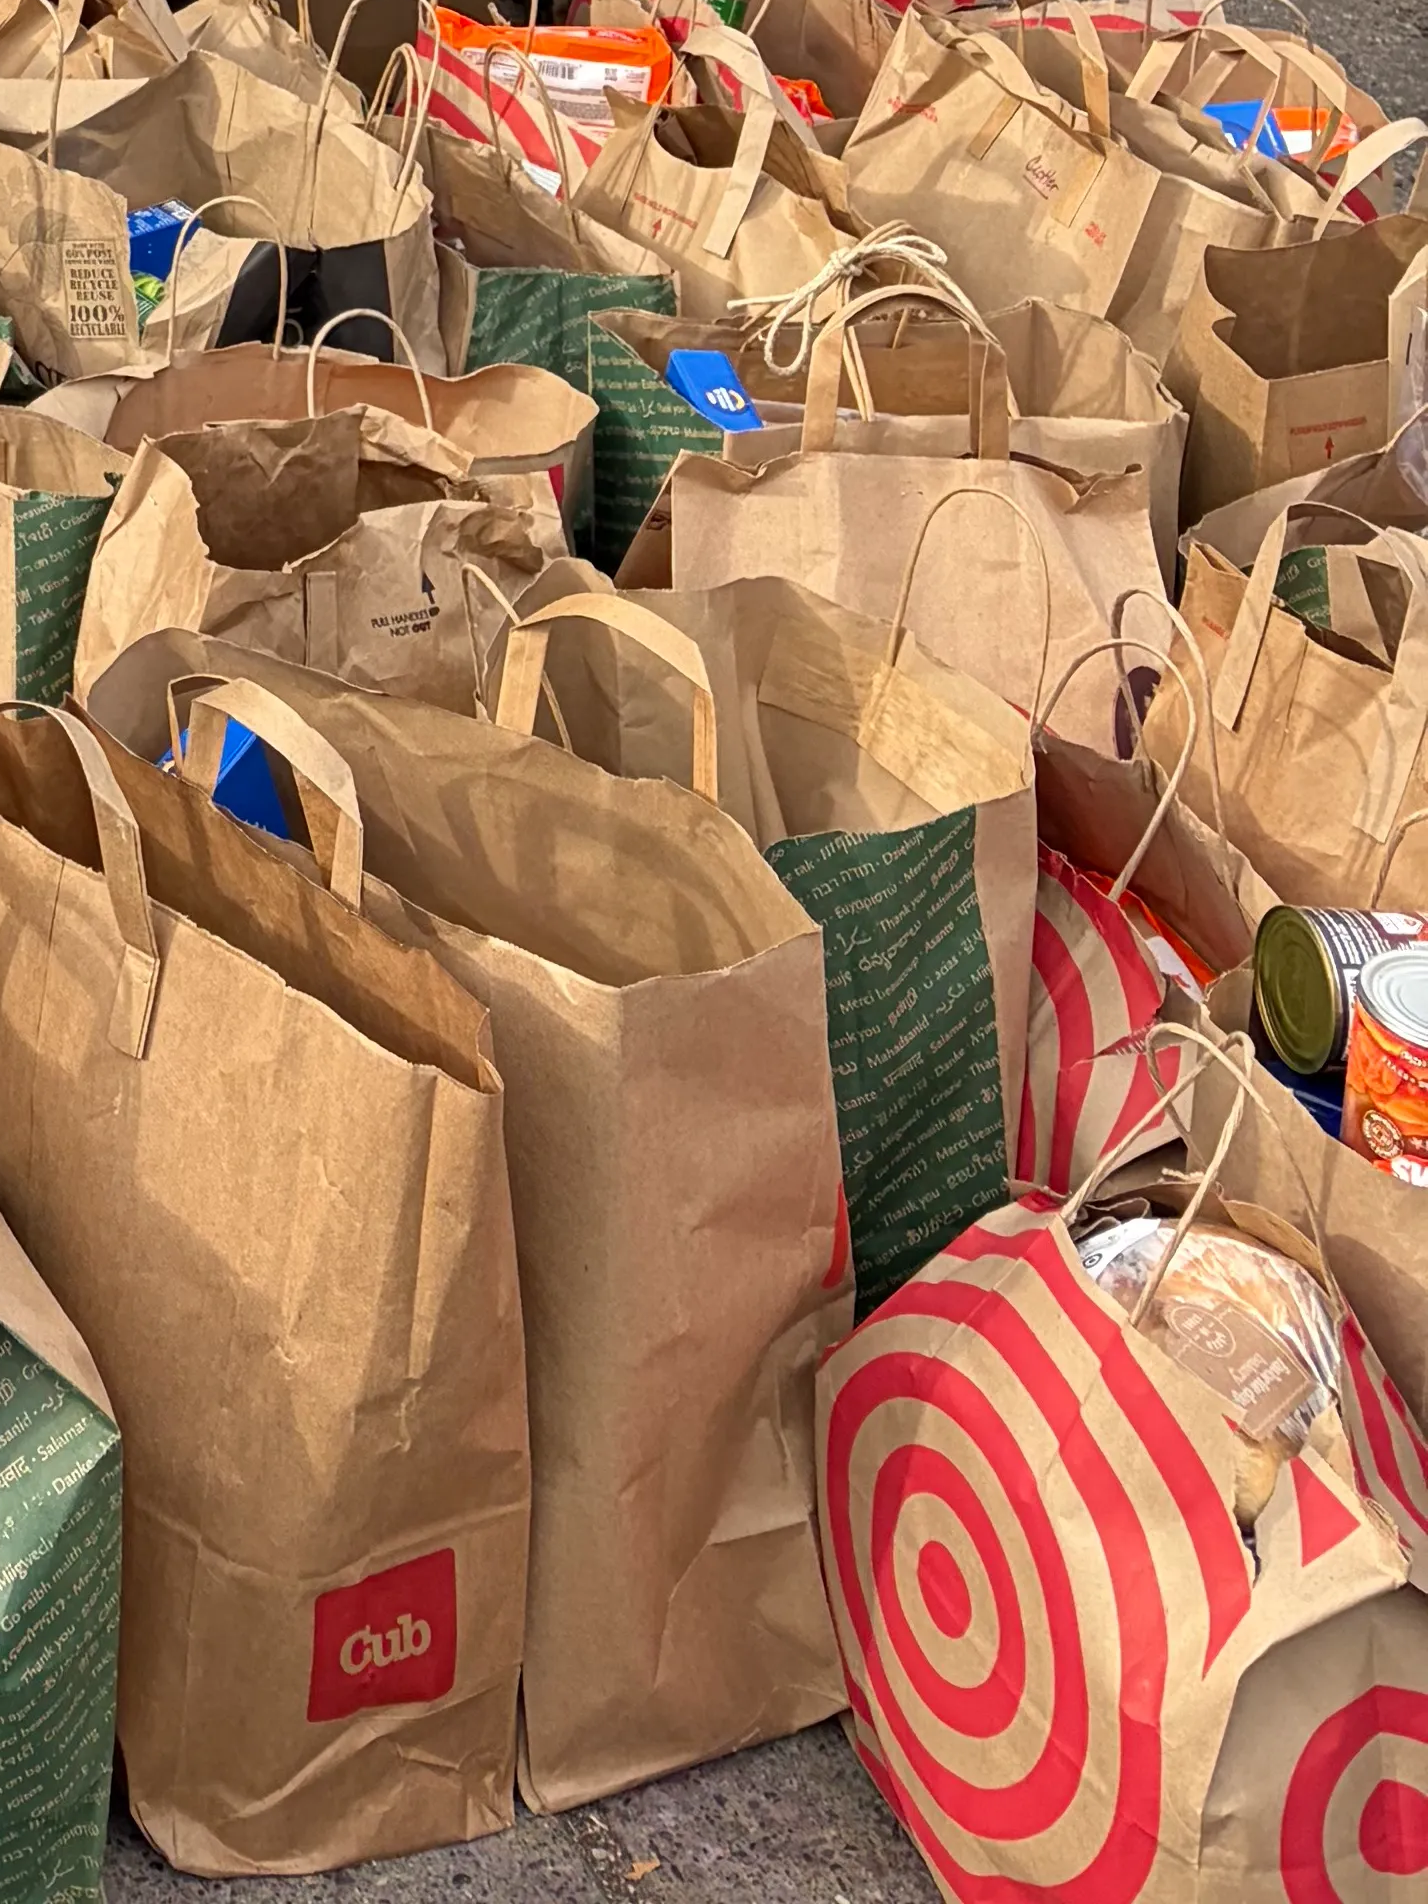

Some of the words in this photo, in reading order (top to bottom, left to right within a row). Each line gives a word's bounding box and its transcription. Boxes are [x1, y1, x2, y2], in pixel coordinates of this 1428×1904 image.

[70, 269, 115, 279] REDUCE
[70, 280, 118, 290] RECYCLE
[77, 291, 115, 301] REUSE
[70, 305, 124, 322] 100%
[38, 1415, 89, 1464] Salamat
[51, 1454, 95, 1496] Danke
[338, 1612, 434, 1681] Cub
